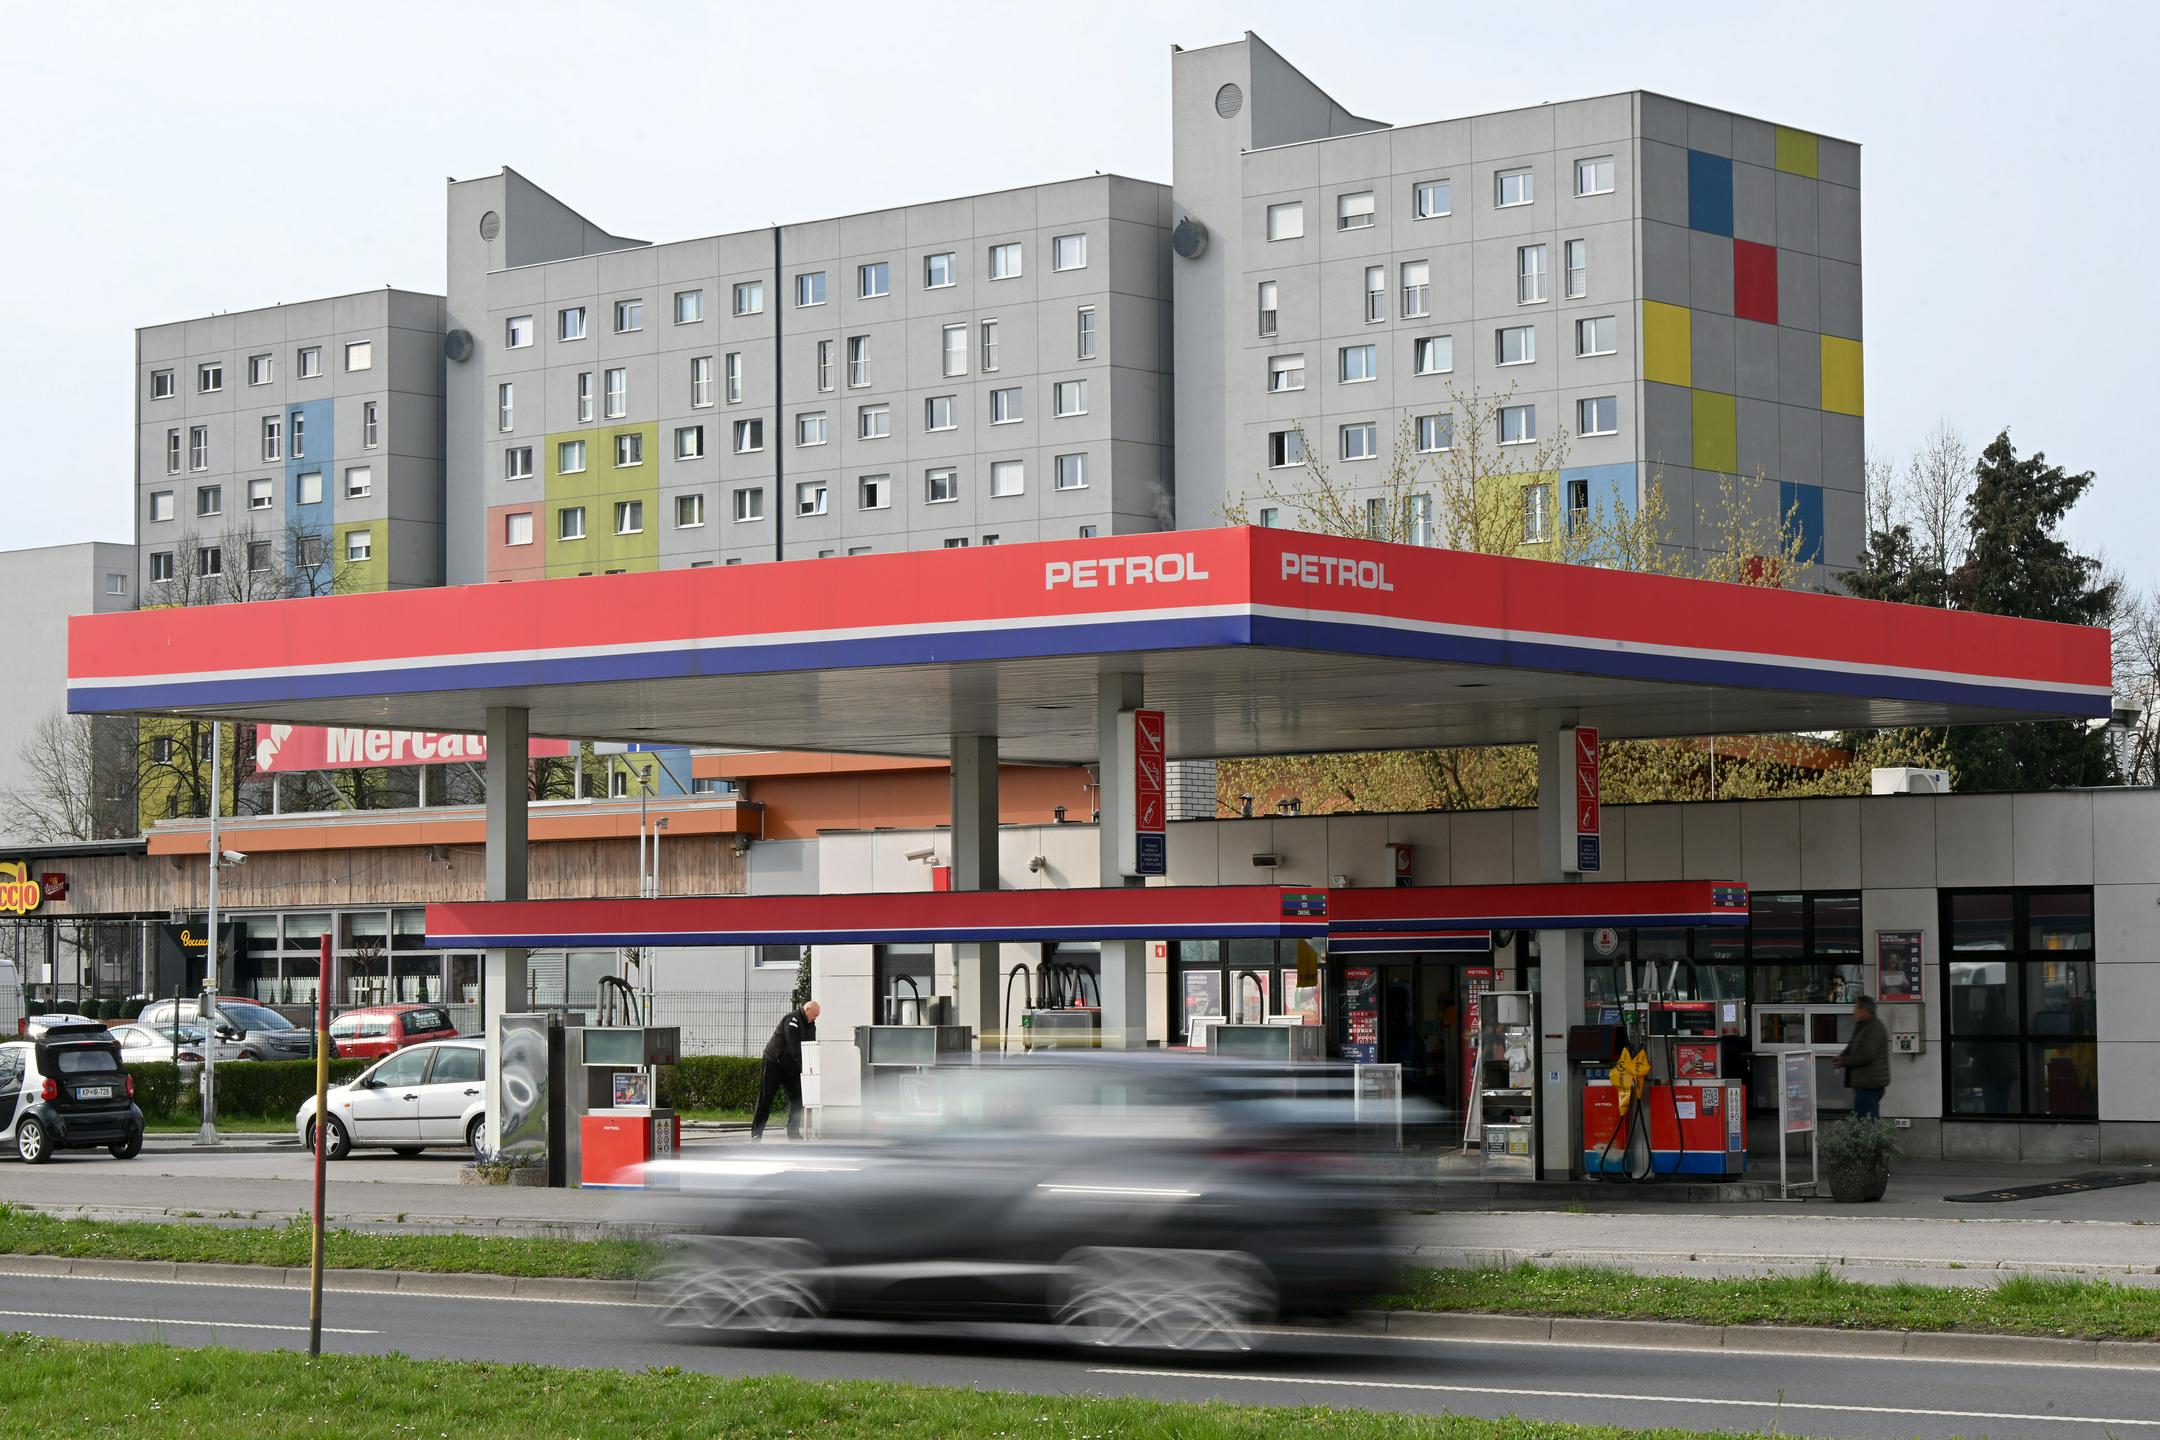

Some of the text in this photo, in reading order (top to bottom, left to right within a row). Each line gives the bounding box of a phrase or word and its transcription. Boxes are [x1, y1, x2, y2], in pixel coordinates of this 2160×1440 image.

[1045, 552, 1209, 591] PETROL
[1281, 551, 1394, 592] PETROL
[327, 728, 487, 763] Mercat
